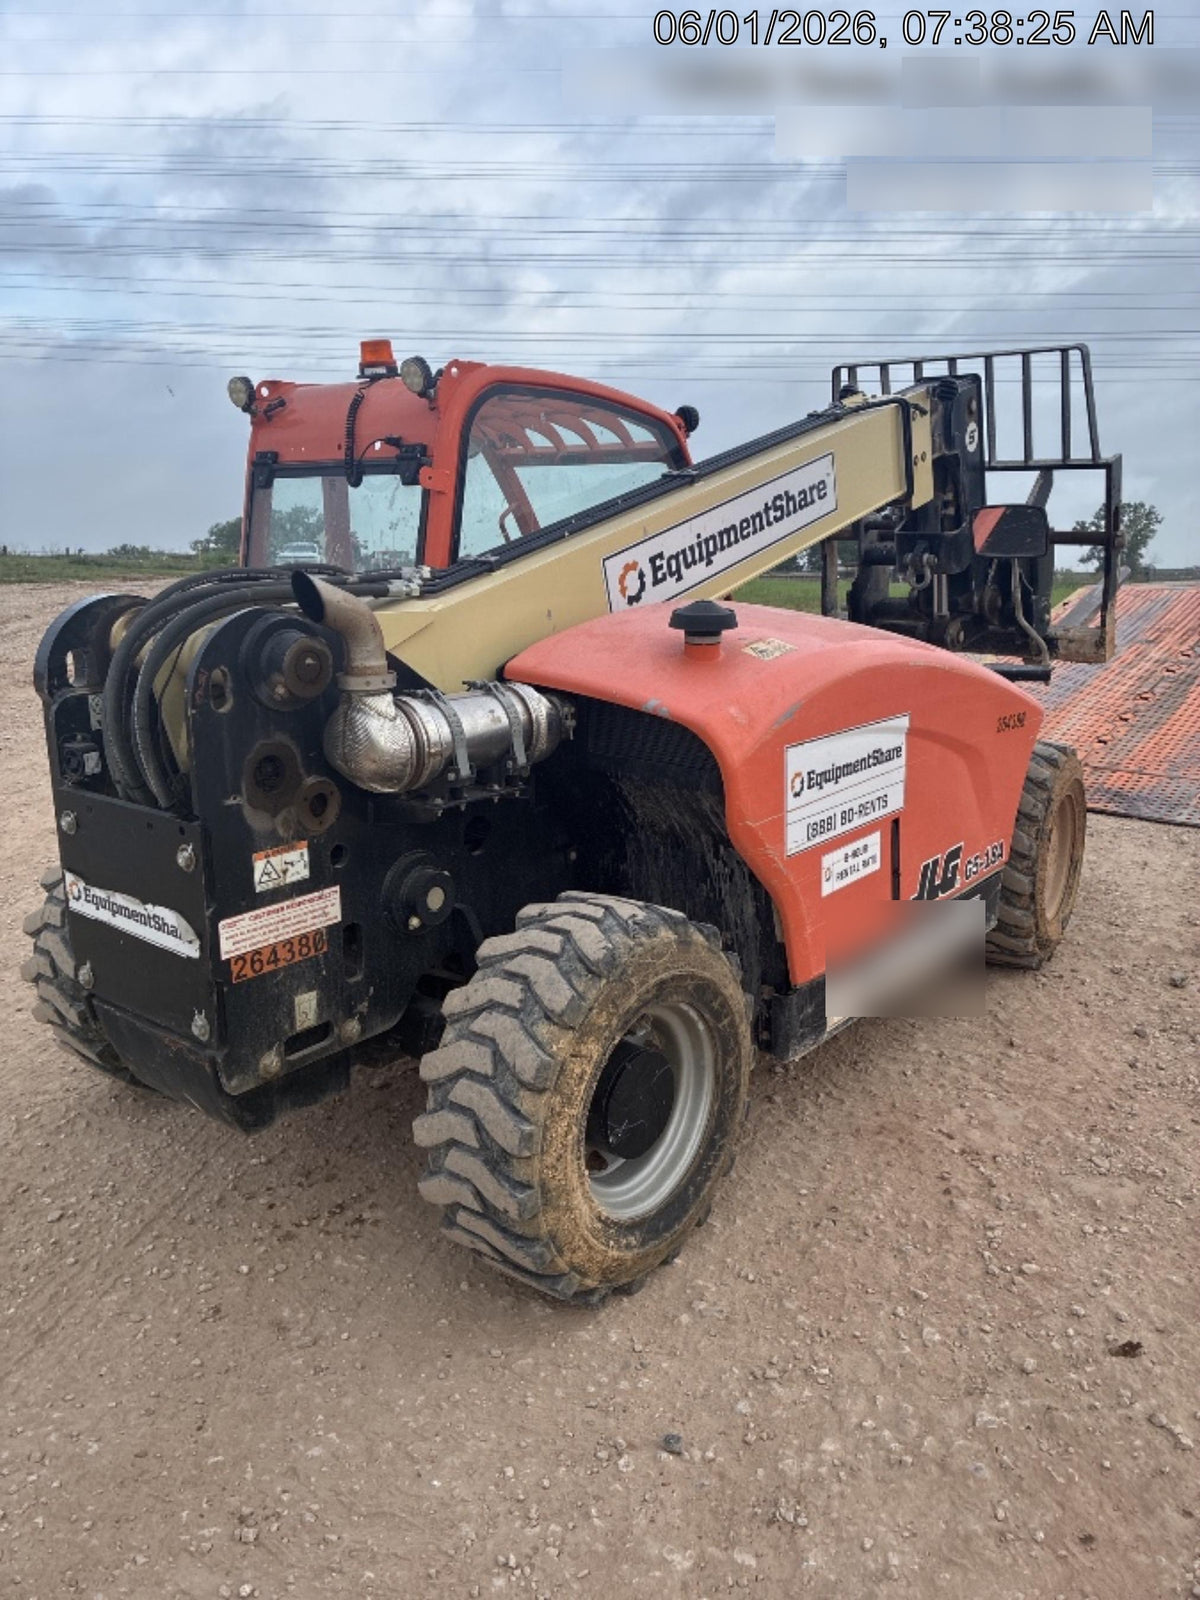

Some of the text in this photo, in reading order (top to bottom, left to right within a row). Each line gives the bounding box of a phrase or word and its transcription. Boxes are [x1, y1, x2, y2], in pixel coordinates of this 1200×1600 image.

[649, 478, 828, 589] EquipmentShare
[806, 745, 903, 791] EquipmentShare
[806, 813, 837, 841] (888)
[911, 842, 964, 900] JLG
[83, 886, 192, 945] EquipmentSha
[233, 929, 325, 981] 264380
